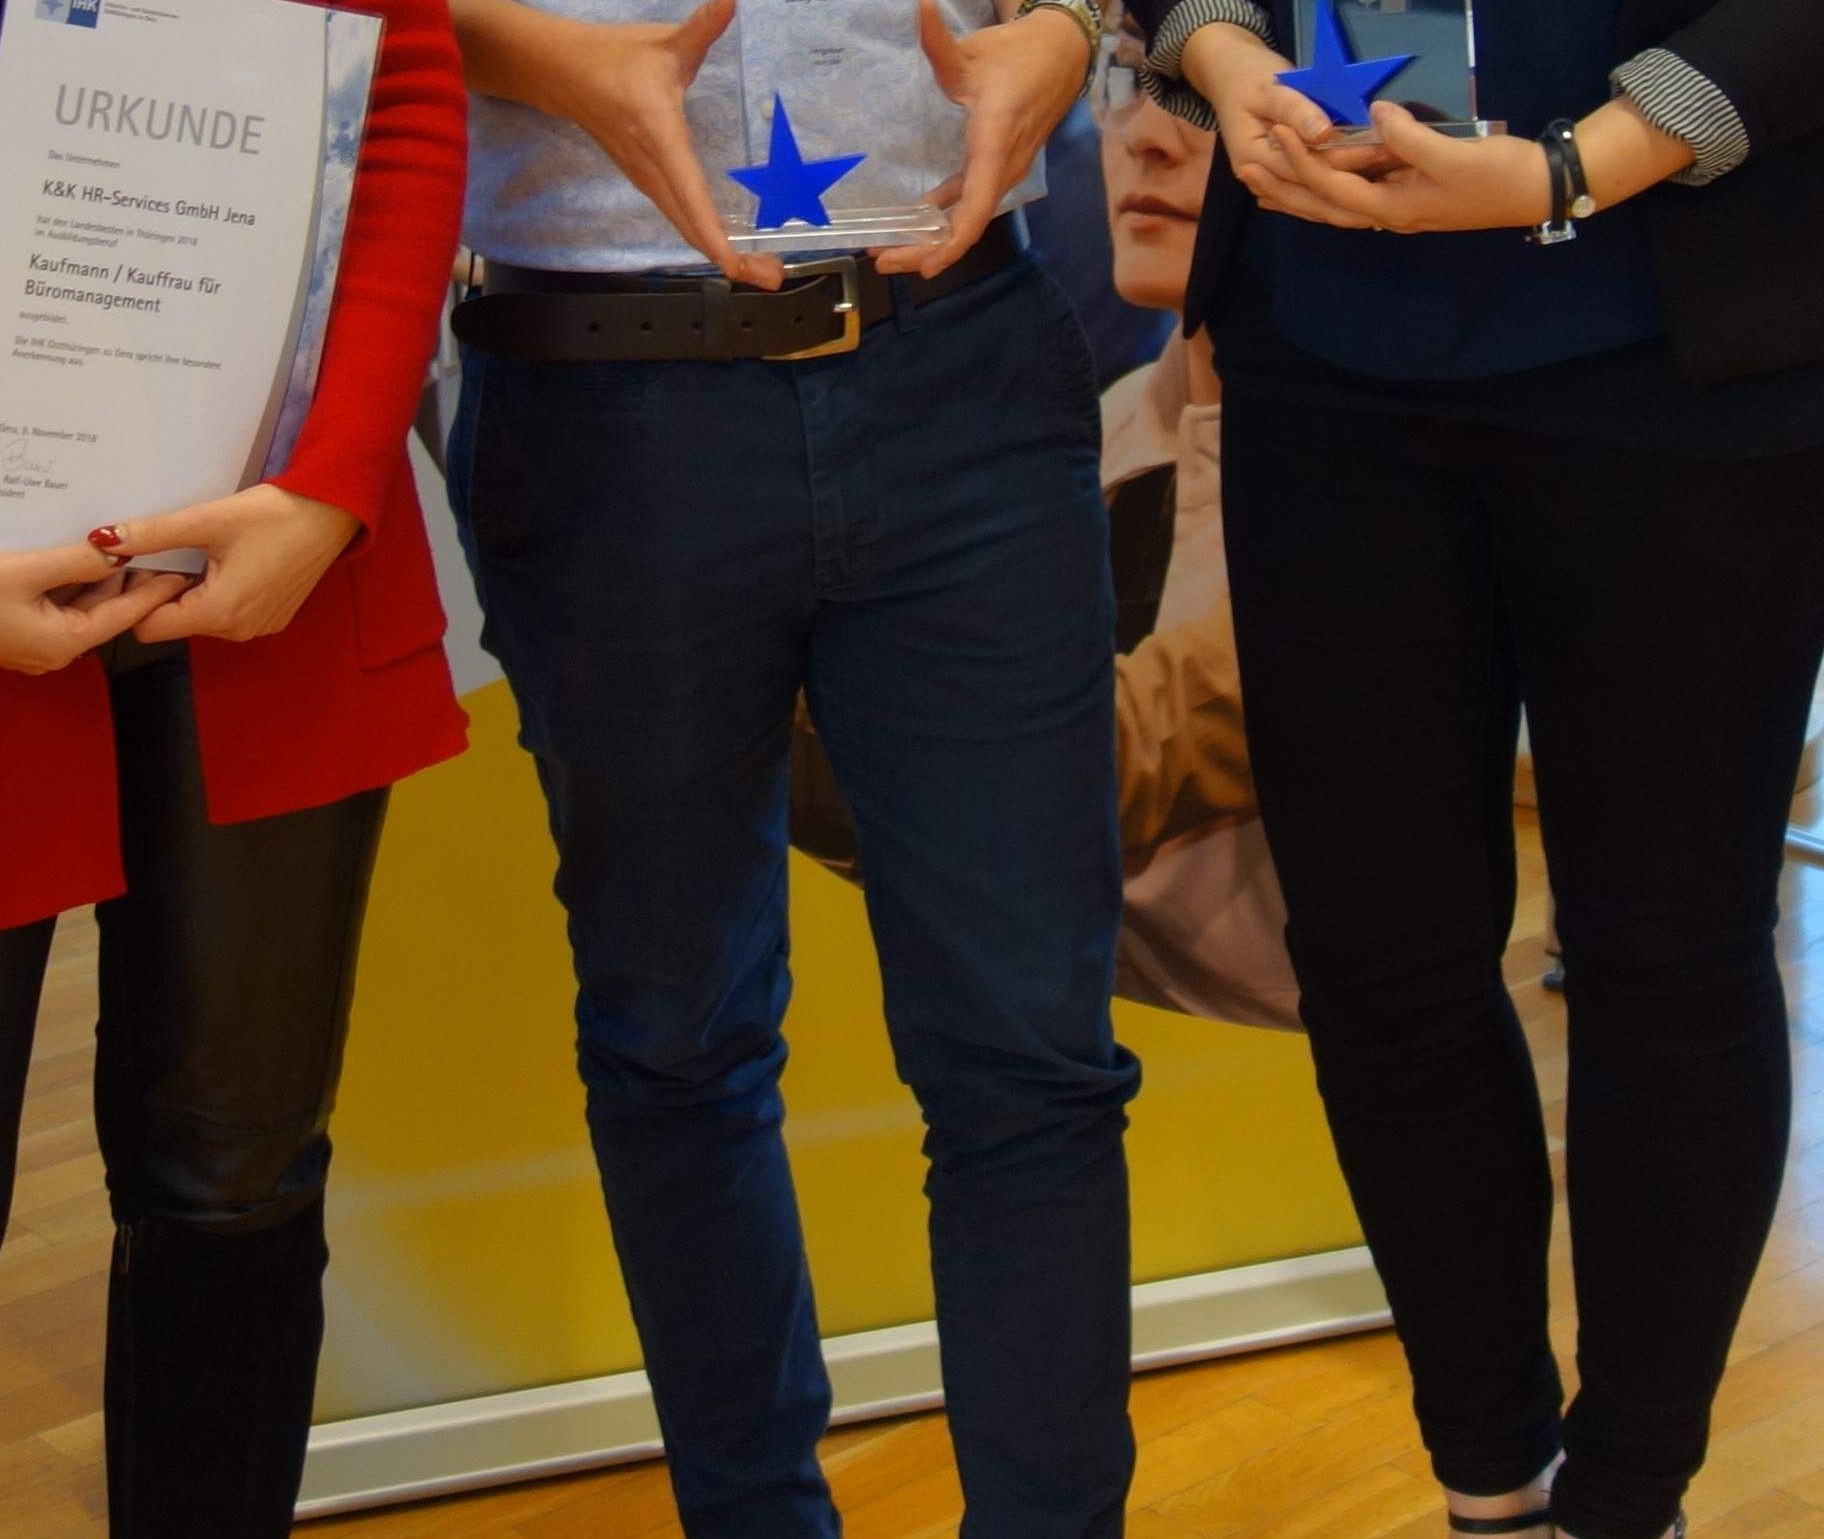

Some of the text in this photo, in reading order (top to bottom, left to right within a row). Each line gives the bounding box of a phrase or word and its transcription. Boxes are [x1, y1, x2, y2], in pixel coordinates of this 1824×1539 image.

[54, 83, 266, 155] URKUNDE
[42, 178, 257, 227] K&K HR-Services GmbH Jena
[24, 278, 162, 313] Büromanagement
[28, 253, 222, 295] Kaufmann / Kauffrau für
